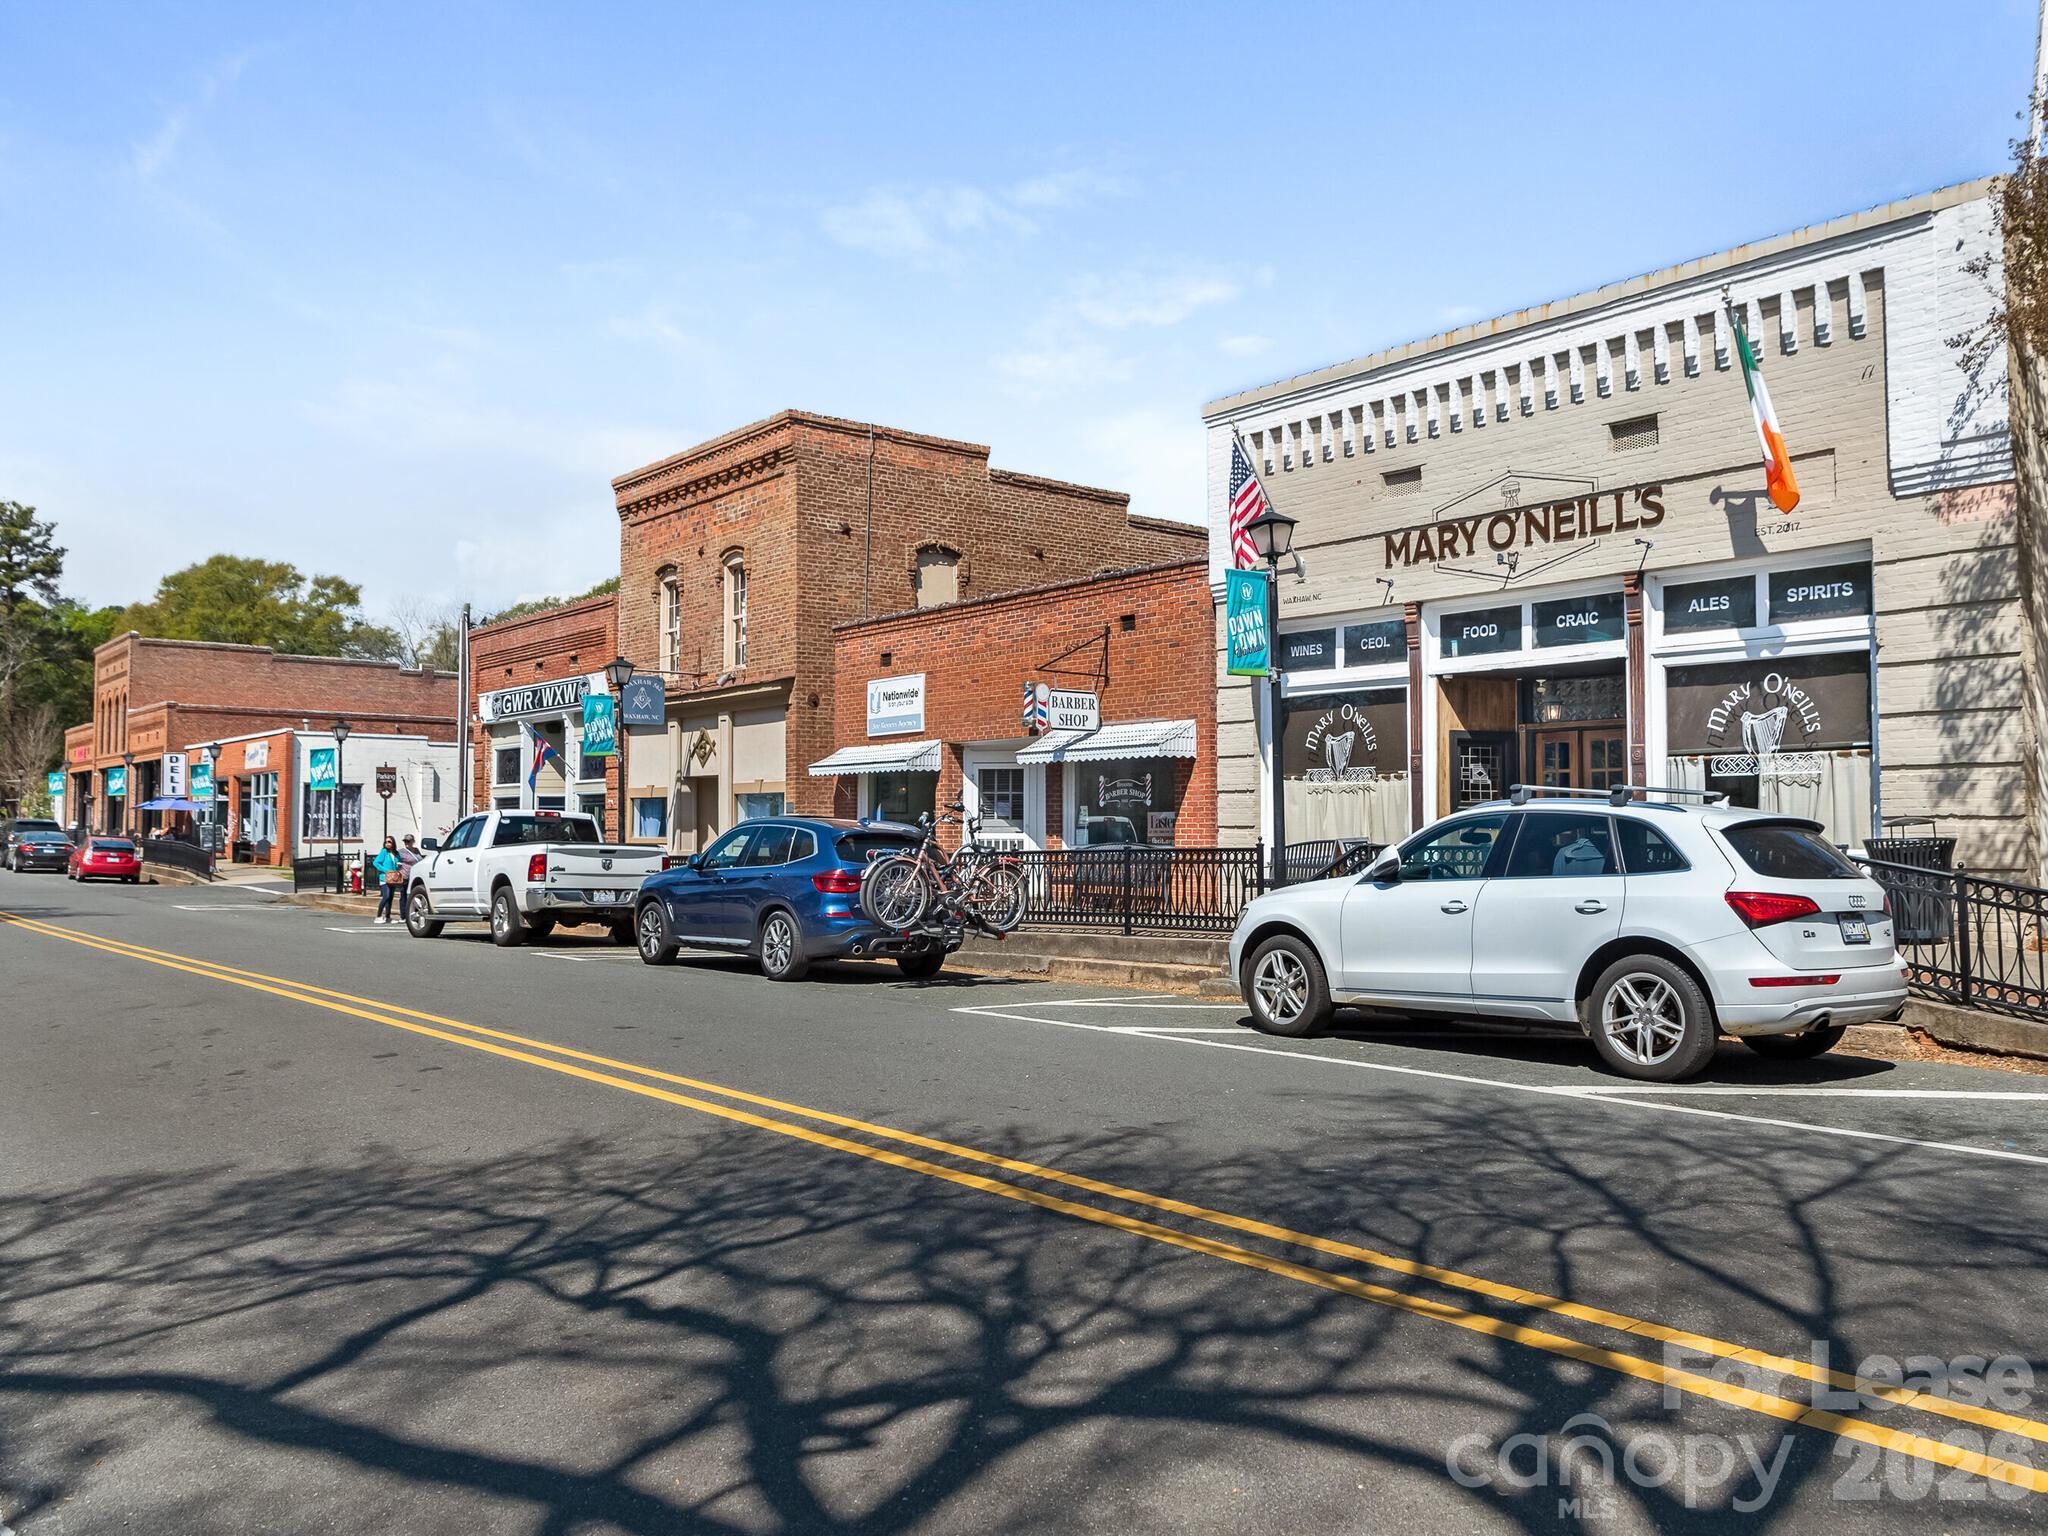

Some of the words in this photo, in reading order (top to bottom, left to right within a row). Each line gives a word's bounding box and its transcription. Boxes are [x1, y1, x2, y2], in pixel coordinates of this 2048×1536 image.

[1384, 520, 1482, 569] MARY
[1487, 486, 1666, 546] O'NEILL'S
[1776, 522, 1801, 535] 2017
[1312, 593, 1322, 601] NC
[1786, 581, 1853, 603] SPIRITS
[1688, 595, 1730, 613] ALES
[1228, 609, 1264, 636] DOWN
[1555, 611, 1599, 629] CRAIC
[1462, 623, 1498, 640] FOOD
[1290, 643, 1323, 657] WINES
[1360, 636, 1391, 650] CEOL
[502, 691, 533, 714] GWR
[541, 682, 578, 708] WXW
[882, 688, 919, 702] Nationwide
[1051, 695, 1096, 711] BARBER
[584, 715, 610, 734] DOWN
[1058, 713, 1089, 727] SHOP
[588, 726, 614, 744] TOWN
[169, 755, 180, 794] DELI
[376, 773, 396, 781] Parking
[1104, 788, 1128, 800] BARBER
[1129, 788, 1146, 799] SHOP
